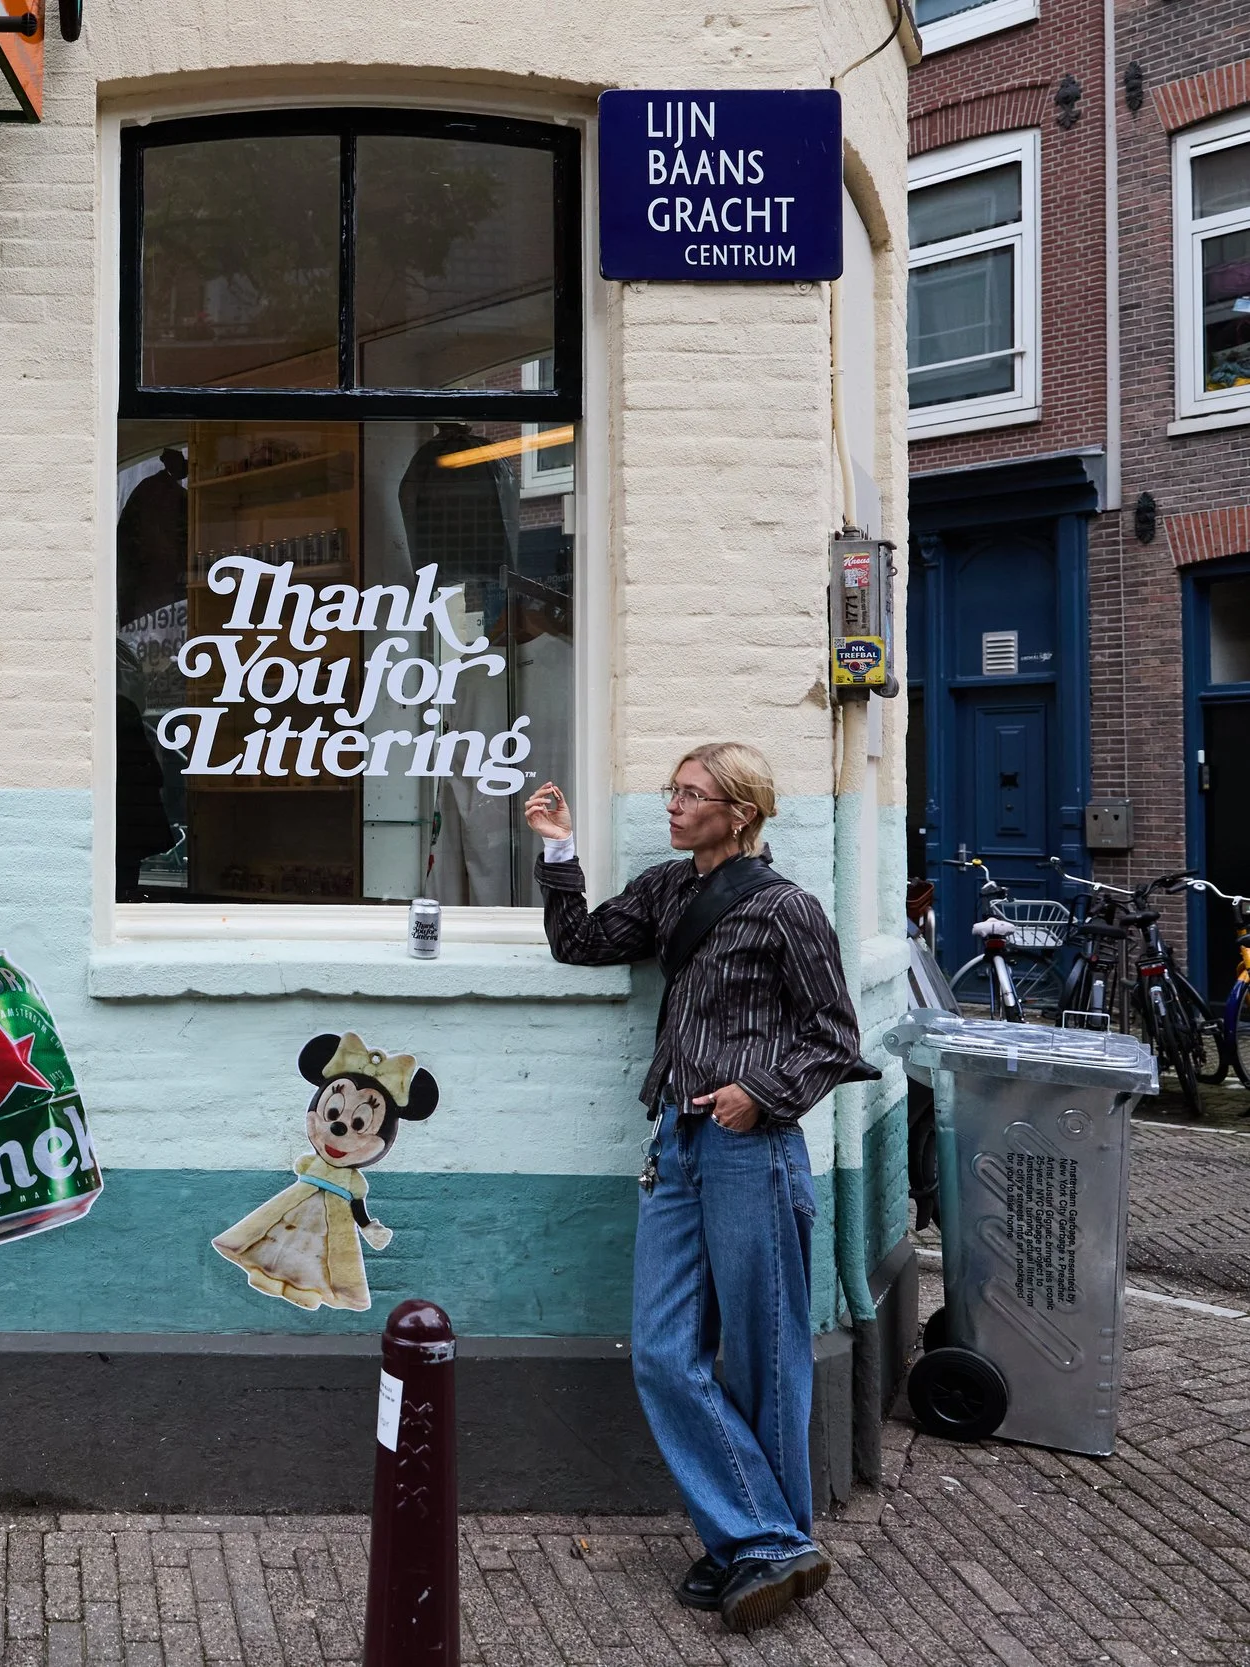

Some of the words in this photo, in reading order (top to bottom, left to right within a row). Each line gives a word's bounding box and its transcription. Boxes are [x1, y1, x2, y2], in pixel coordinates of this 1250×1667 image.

[647, 101, 715, 149] LIJN
[648, 149, 765, 185] BAANS
[647, 197, 795, 233] GRACHT
[684, 244, 796, 267] CENTRUM
[207, 555, 491, 652] Thank
[845, 595, 859, 626] 1771
[838, 651, 878, 660] TREFBAL
[851, 645, 866, 653] NK
[177, 634, 349, 705] You
[334, 636, 506, 727] for
[156, 706, 531, 797] Littering
[0, 1007, 48, 1035] AMSTERDAM
[1007, 1152, 1015, 1164] for
[1017, 1154, 1025, 1166] the
[1046, 1156, 1055, 1179] Artist
[1059, 1158, 1067, 1176] New
[1005, 1166, 1014, 1181] you
[1069, 1159, 1077, 1206] Amsterdam
[1007, 1184, 1015, 1192] to
[1036, 1188, 1044, 1206] NYC
[1045, 1182, 1054, 1207] Justin
[1059, 1179, 1067, 1197] York
[1007, 1195, 1015, 1212] take
[1057, 1200, 1067, 1216] City
[1025, 1207, 1034, 1236] turning
[1034, 1209, 1044, 1244] Garbage
[1044, 1210, 1054, 1239] Gignac
[1057, 1219, 1067, 1254] Garbage
[1026, 1239, 1034, 1264] actual
[1034, 1247, 1044, 1276] project
[1043, 1242, 1054, 1268] brings
[1015, 1258, 1025, 1298] packaged
[1026, 1266, 1034, 1285] litter
[1036, 1278, 1044, 1286] to
[1046, 1271, 1054, 1282] his
[1057, 1264, 1066, 1302] Preacher.
[1067, 1250, 1076, 1291] presented
[1046, 1285, 1054, 1311] iconic
[1066, 1294, 1075, 1304] by
